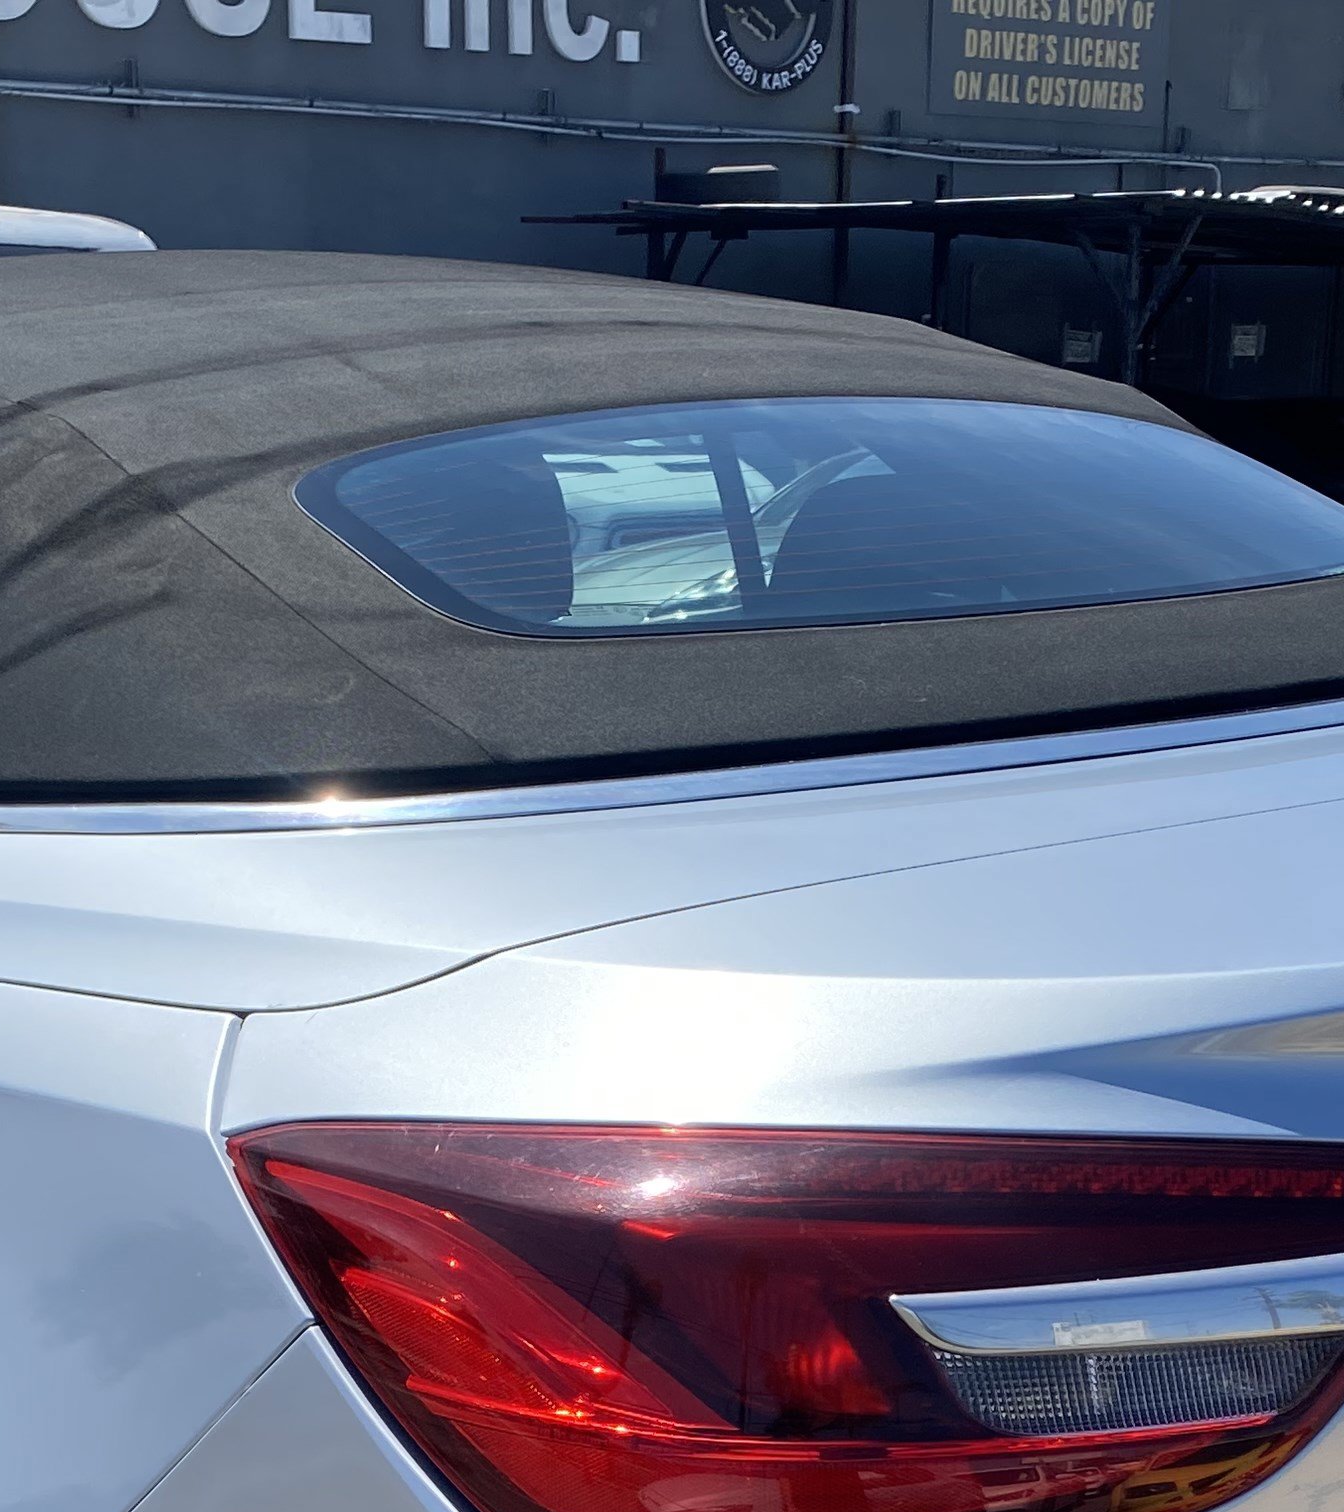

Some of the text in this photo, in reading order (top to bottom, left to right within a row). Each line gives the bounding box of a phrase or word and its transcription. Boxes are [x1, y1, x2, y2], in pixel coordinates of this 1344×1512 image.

[1058, 0, 1071, 23] A
[1076, 0, 1128, 28] COPY
[1132, 0, 1156, 30] OF
[715, 29, 823, 90] 1-(888) KAR-PLUS
[964, 27, 1141, 71] DRIVER'S LICENSE
[954, 69, 1145, 113] ON ALL CUSTOMERS
